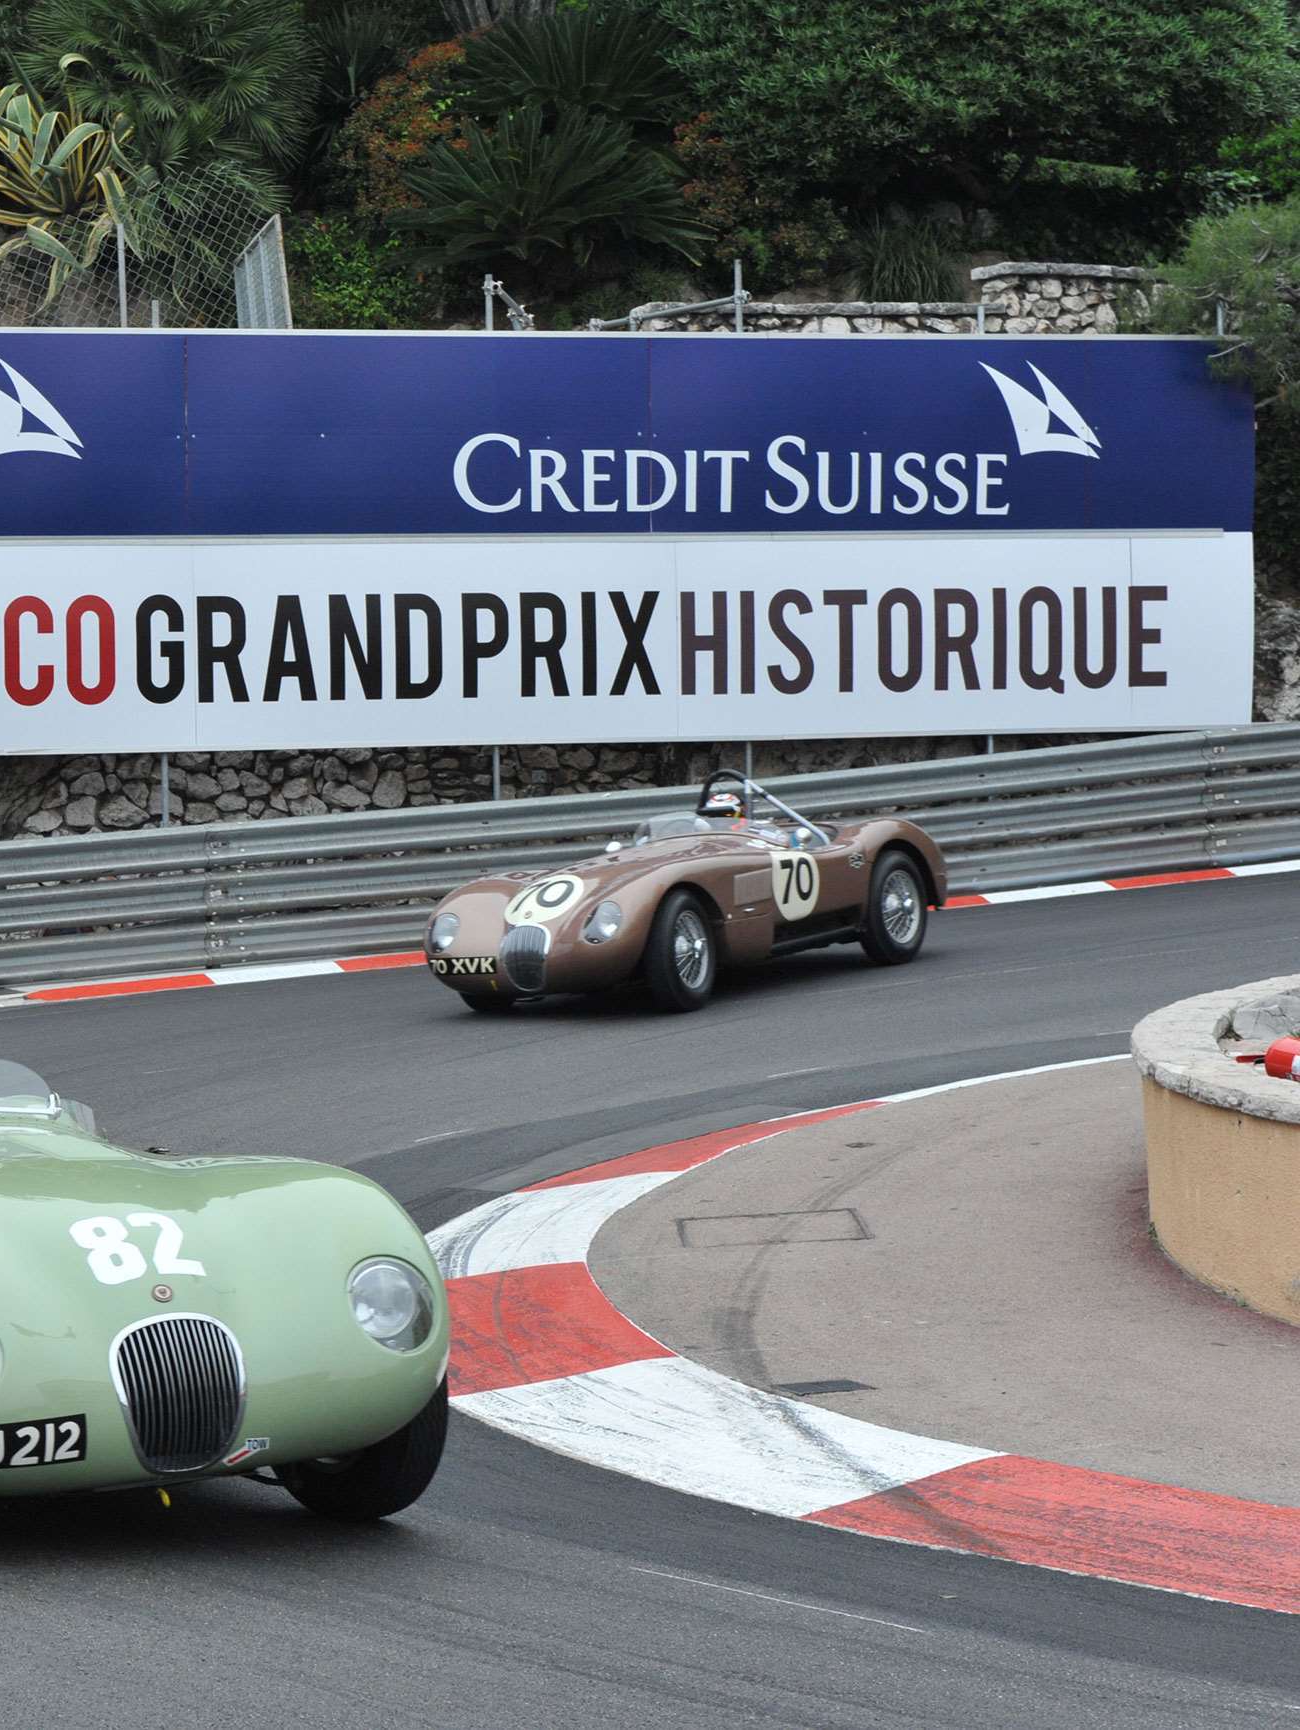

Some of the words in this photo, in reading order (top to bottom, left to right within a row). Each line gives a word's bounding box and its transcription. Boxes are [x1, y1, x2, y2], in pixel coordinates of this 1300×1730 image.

[452, 432, 751, 513] CREDIT
[765, 435, 1011, 515] SUISSE
[680, 585, 1168, 696] HISTORIQUE
[511, 879, 575, 914] 70
[780, 857, 813, 905] 70
[452, 957, 495, 974] XVK
[68, 1212, 207, 1285] 82
[10, 1421, 82, 1466] 212
